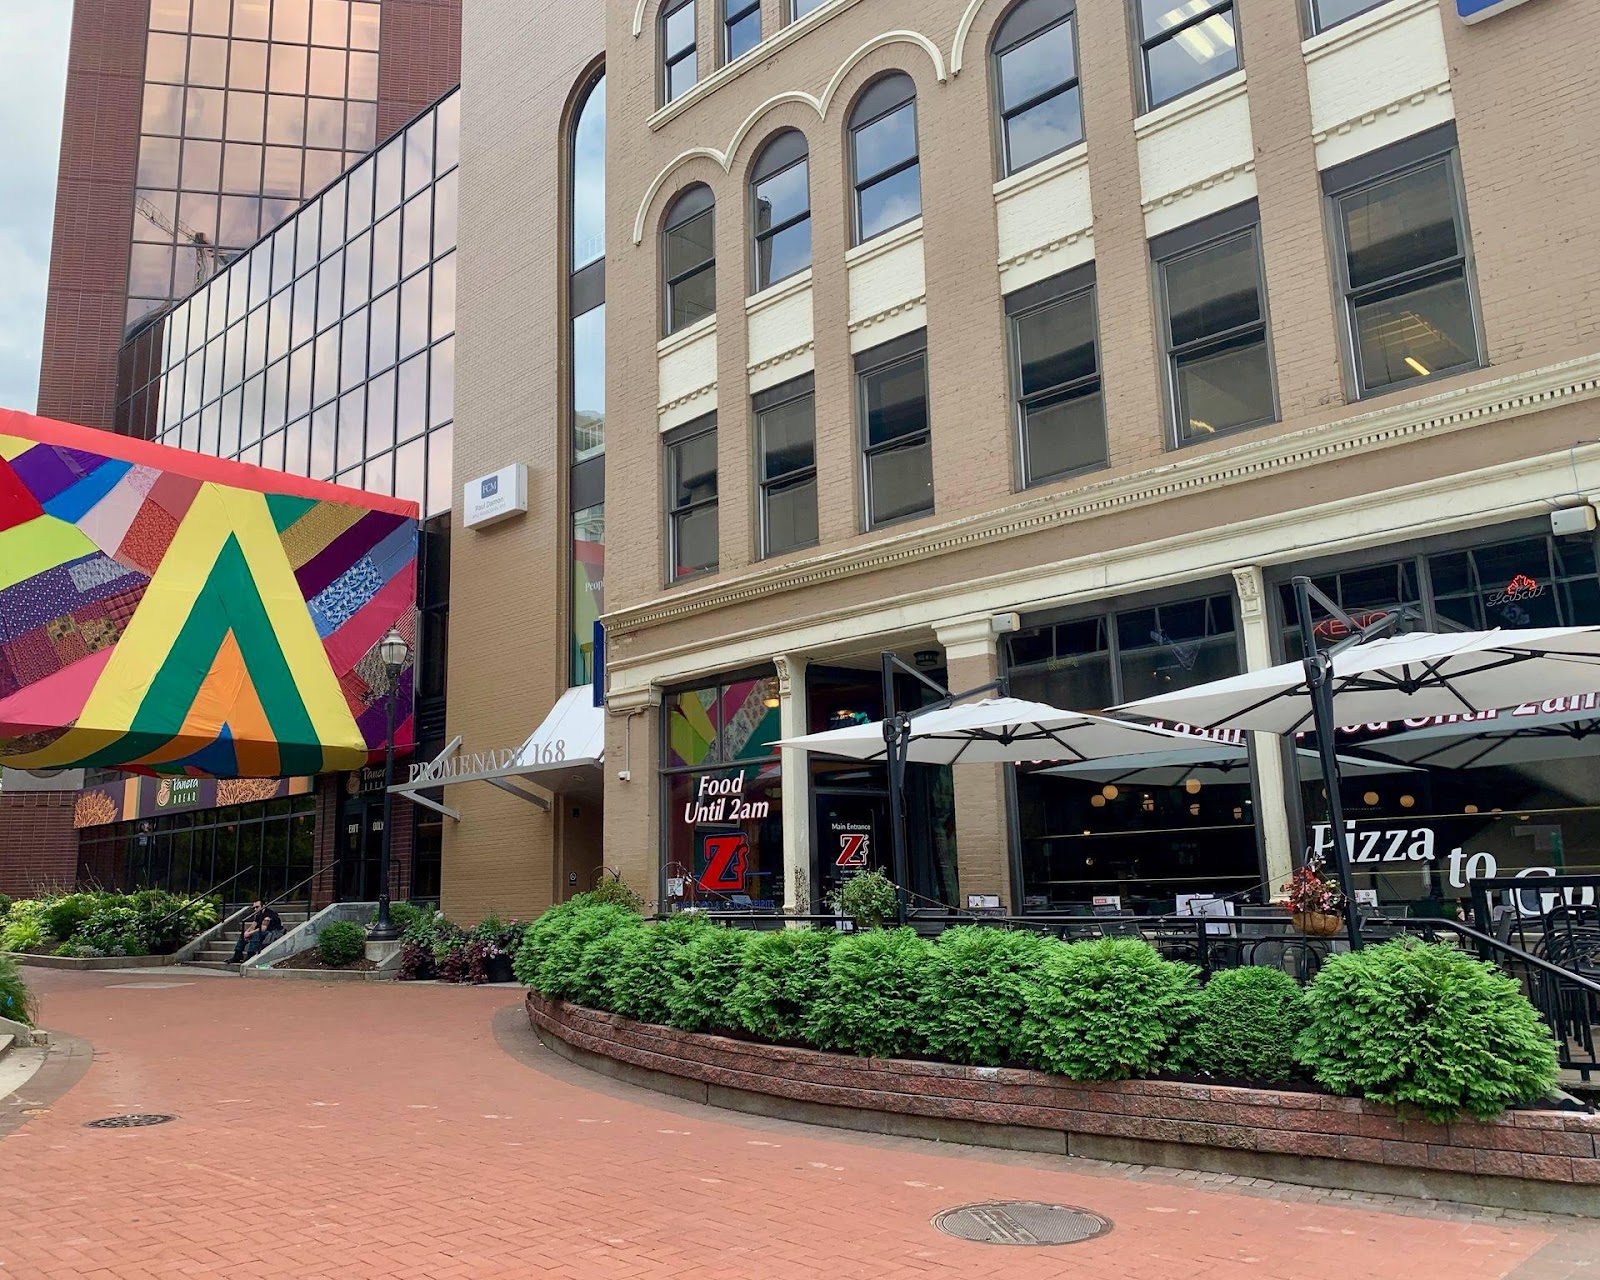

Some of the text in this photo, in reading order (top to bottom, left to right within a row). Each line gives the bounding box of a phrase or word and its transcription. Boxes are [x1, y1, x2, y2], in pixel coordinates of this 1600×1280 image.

[363, 767, 387, 780] Paner
[407, 739, 566, 783] PROMENADE 168
[698, 770, 745, 796] Food
[684, 798, 770, 823] Until 2am
[1312, 820, 1435, 864] Pizza
[1448, 848, 1497, 888] to
